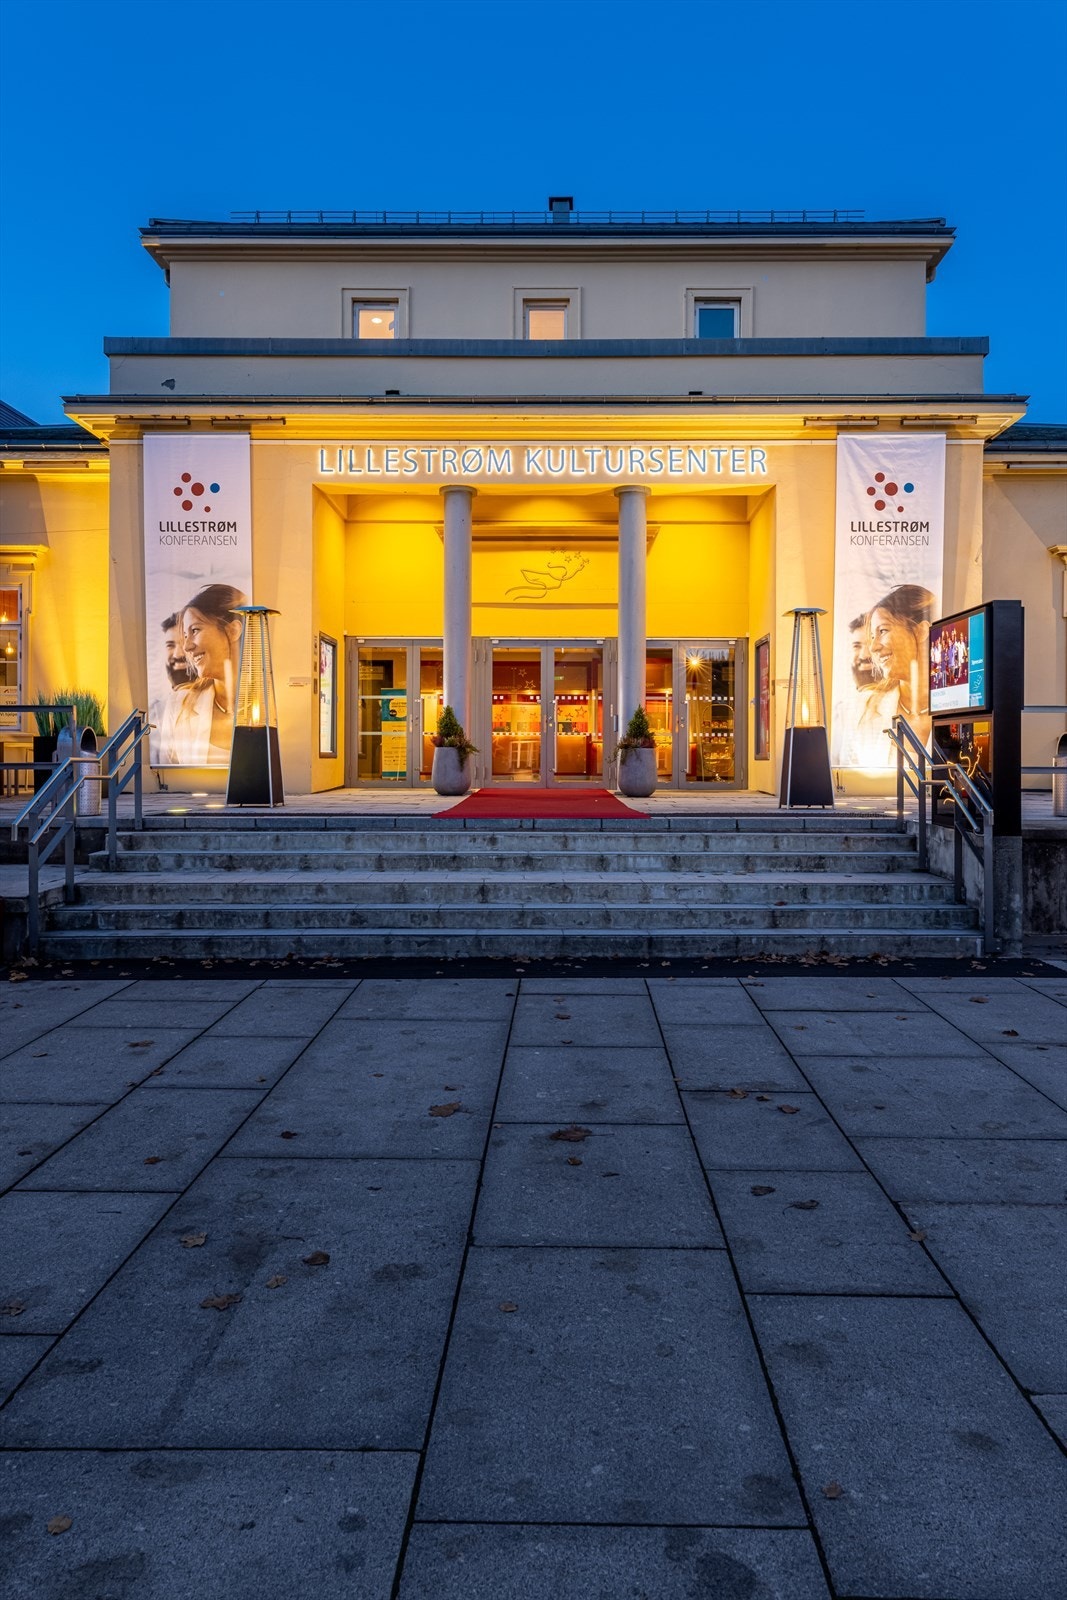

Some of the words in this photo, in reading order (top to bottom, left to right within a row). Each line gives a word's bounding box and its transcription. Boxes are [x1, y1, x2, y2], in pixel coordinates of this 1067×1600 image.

[320, 448, 512, 474] LILLESTRØM
[526, 448, 767, 474] KULTURSENTER
[159, 521, 237, 533] LILLESTRØM
[850, 521, 930, 533] LILLESTRØM
[159, 535, 238, 546] KONFERANSEN
[850, 535, 930, 546] KONFERANSEN
